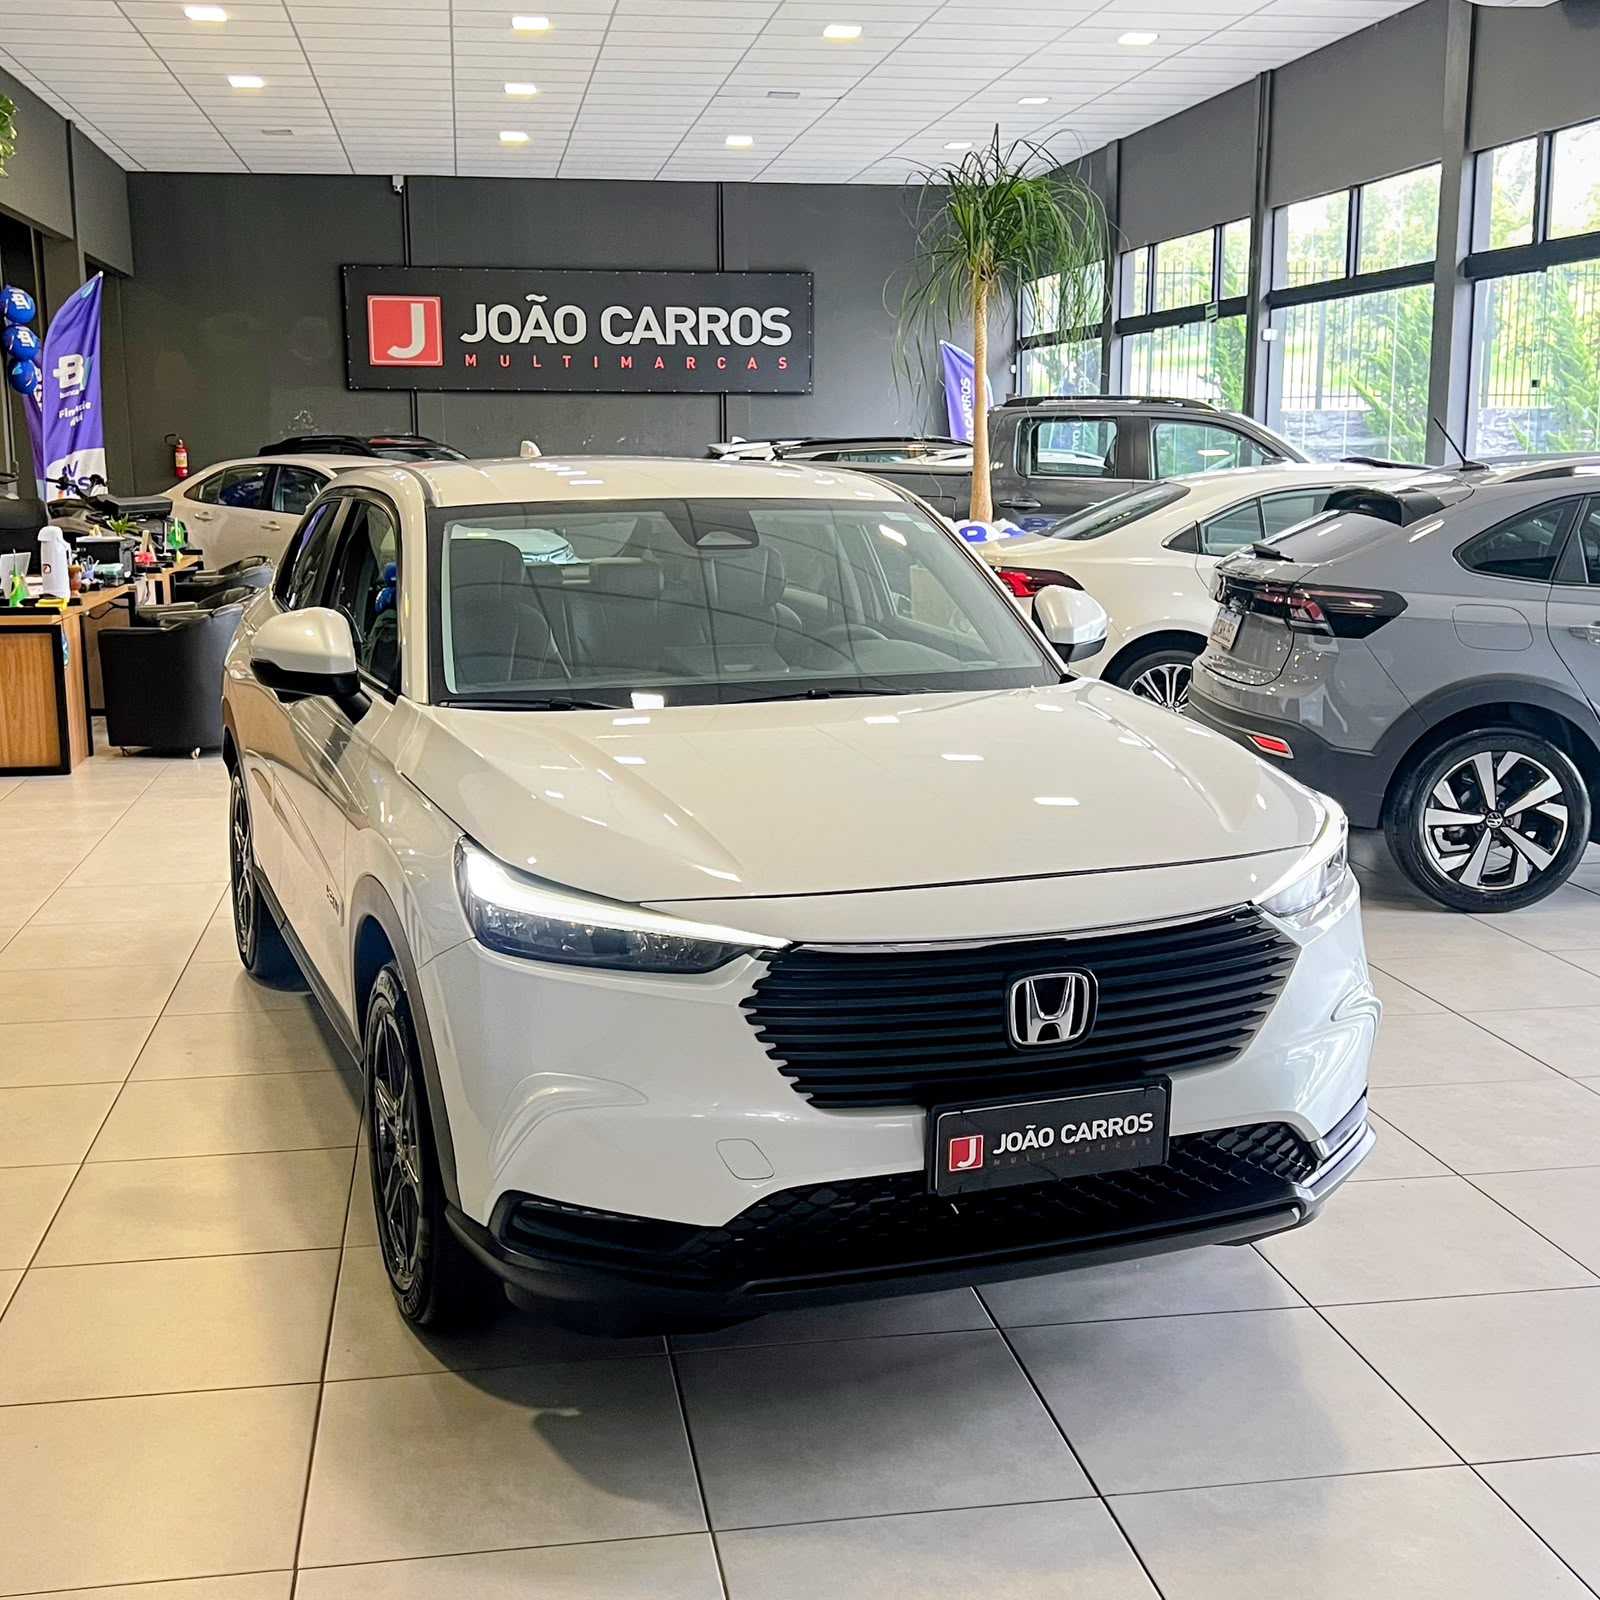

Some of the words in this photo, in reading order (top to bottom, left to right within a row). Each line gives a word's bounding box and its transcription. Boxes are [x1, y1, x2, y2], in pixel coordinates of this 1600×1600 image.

[387, 303, 425, 360] J
[459, 293, 588, 345] JOÃO
[600, 305, 793, 347] CARROS
[464, 353, 789, 370] MULTIMARCAS
[960, 376, 974, 430] CARROS
[956, 1137, 978, 1168] J
[992, 1124, 1055, 1155] JOÃO
[1060, 1112, 1154, 1145] CARROS
